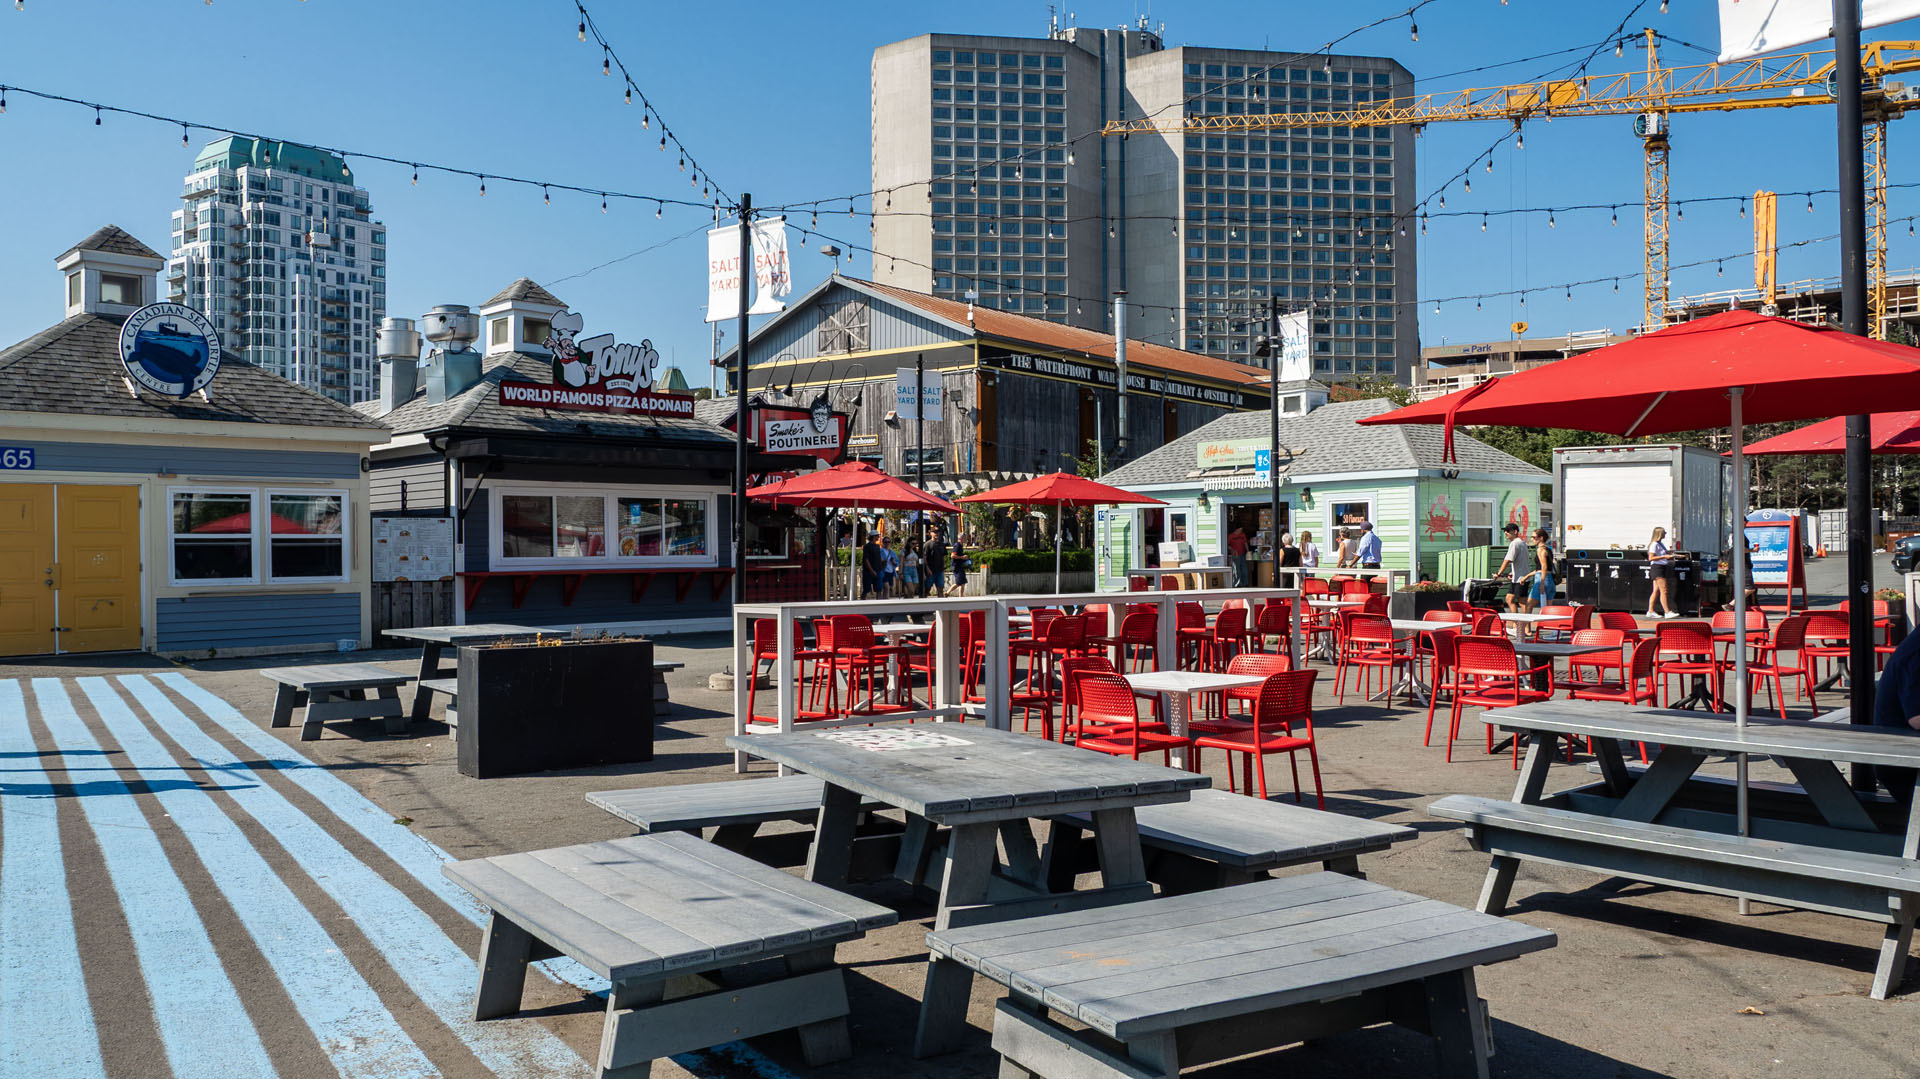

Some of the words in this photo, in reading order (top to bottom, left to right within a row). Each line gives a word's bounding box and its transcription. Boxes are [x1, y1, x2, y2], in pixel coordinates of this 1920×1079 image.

[711, 256, 740, 274] SALT
[756, 250, 786, 269] SALT
[711, 276, 740, 291] YARD
[757, 271, 789, 288] YARD
[126, 305, 185, 339] CANADIAN
[188, 312, 207, 331] SEA
[205, 330, 219, 375] TURTLE
[1282, 334, 1307, 348] SALT
[1471, 344, 1492, 353] Park
[579, 332, 659, 394] Tony's
[1284, 349, 1308, 361] YARD
[135, 368, 171, 392] CENTRE
[1010, 353, 1032, 369] THE
[1034, 358, 1092, 379] WATERFRONT
[1097, 369, 1146, 389] WAROUSE
[1197, 388, 1202, 398] &
[1204, 388, 1229, 402] OYSTER
[897, 385, 916, 395] SALT
[922, 387, 941, 395] SALT
[503, 386, 552, 403] WORLD
[553, 390, 604, 407] FAMOUS
[605, 396, 641, 410] PIZZA
[640, 398, 649, 409] &
[649, 398, 693, 413] DONAIR
[922, 398, 941, 406] YARD
[769, 423, 805, 438] Smoke's
[0, 449, 31, 468] 65
